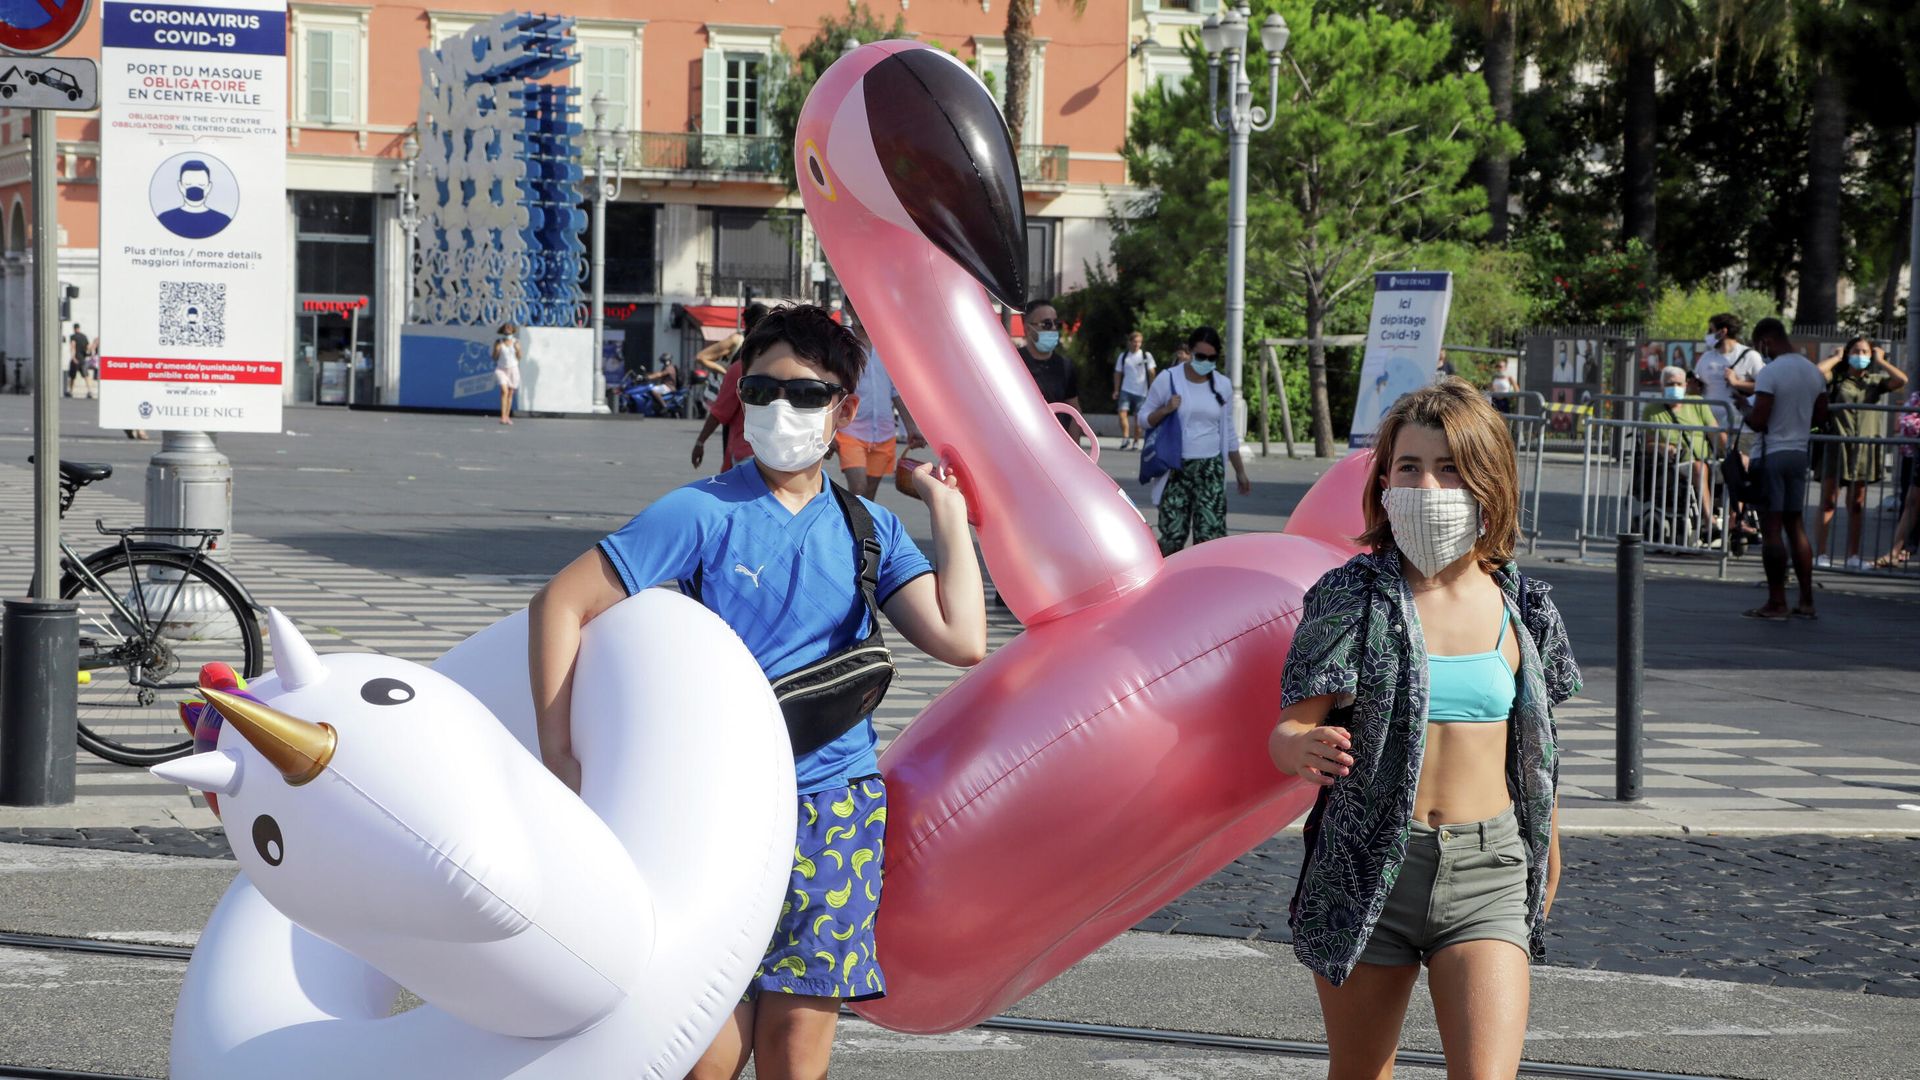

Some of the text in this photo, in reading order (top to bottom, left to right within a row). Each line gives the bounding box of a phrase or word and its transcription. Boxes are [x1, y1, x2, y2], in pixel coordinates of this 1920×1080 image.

[130, 9, 260, 29] CORONAVIRUS
[154, 30, 236, 47] COVID-19
[127, 63, 262, 80] PORT DU MASQUE
[143, 76, 246, 92] OBLIGATOIRE
[128, 88, 261, 105] EN CENTRE-VILLE
[128, 112, 180, 122] OBLIGATORY
[193, 115, 209, 123] THE
[210, 116, 228, 124] CITY
[230, 117, 261, 126] CENTRE
[192, 125, 225, 133] CENTRO
[226, 126, 251, 134] DELLA
[124, 246, 146, 255] Plus
[149, 247, 185, 257] d'infos
[197, 250, 224, 258] more
[227, 250, 262, 260] details
[131, 258, 180, 268] maggiori
[182, 259, 248, 270] informazioni
[1380, 329, 1421, 341] Covid-19
[107, 360, 128, 369] Sous
[129, 361, 153, 371] peine
[246, 364, 257, 373] by
[259, 364, 276, 373] fine
[148, 371, 182, 379] punibile
[201, 372, 210, 380] la
[211, 373, 235, 381] multa
[165, 387, 217, 396] www.nice.fr
[156, 405, 244, 419] VILLE DE NICE
